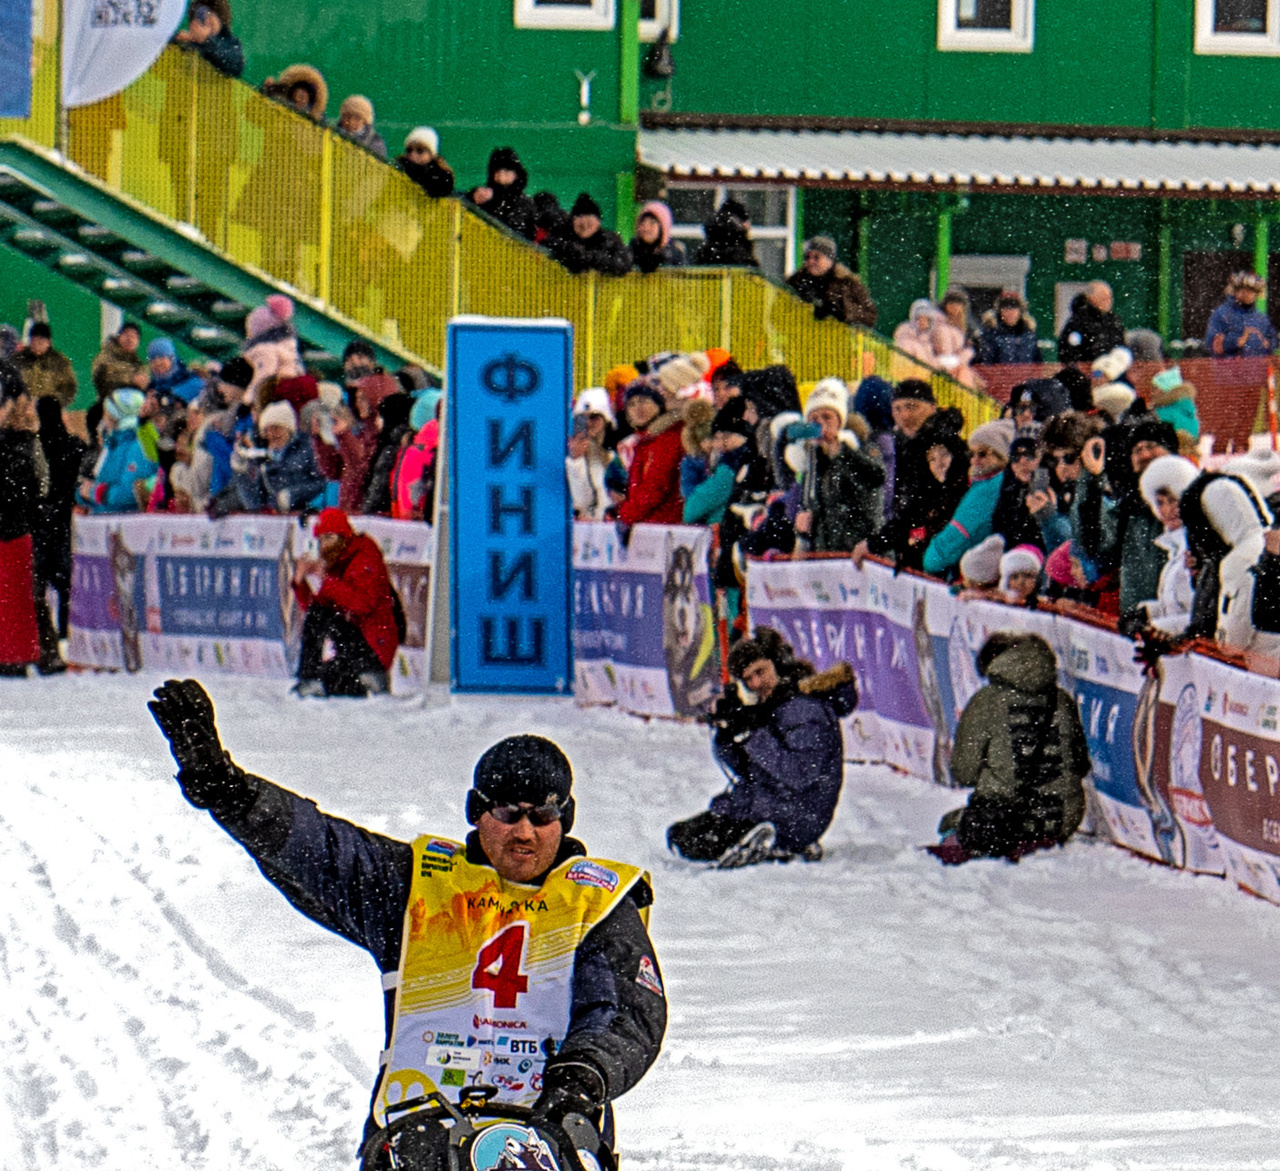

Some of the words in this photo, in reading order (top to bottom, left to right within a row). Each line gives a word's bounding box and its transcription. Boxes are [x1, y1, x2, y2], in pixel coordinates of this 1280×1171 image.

[481, 355, 543, 666] ФИНИШ
[471, 924, 529, 1009] 4
[510, 1039, 538, 1054] ВТБ
